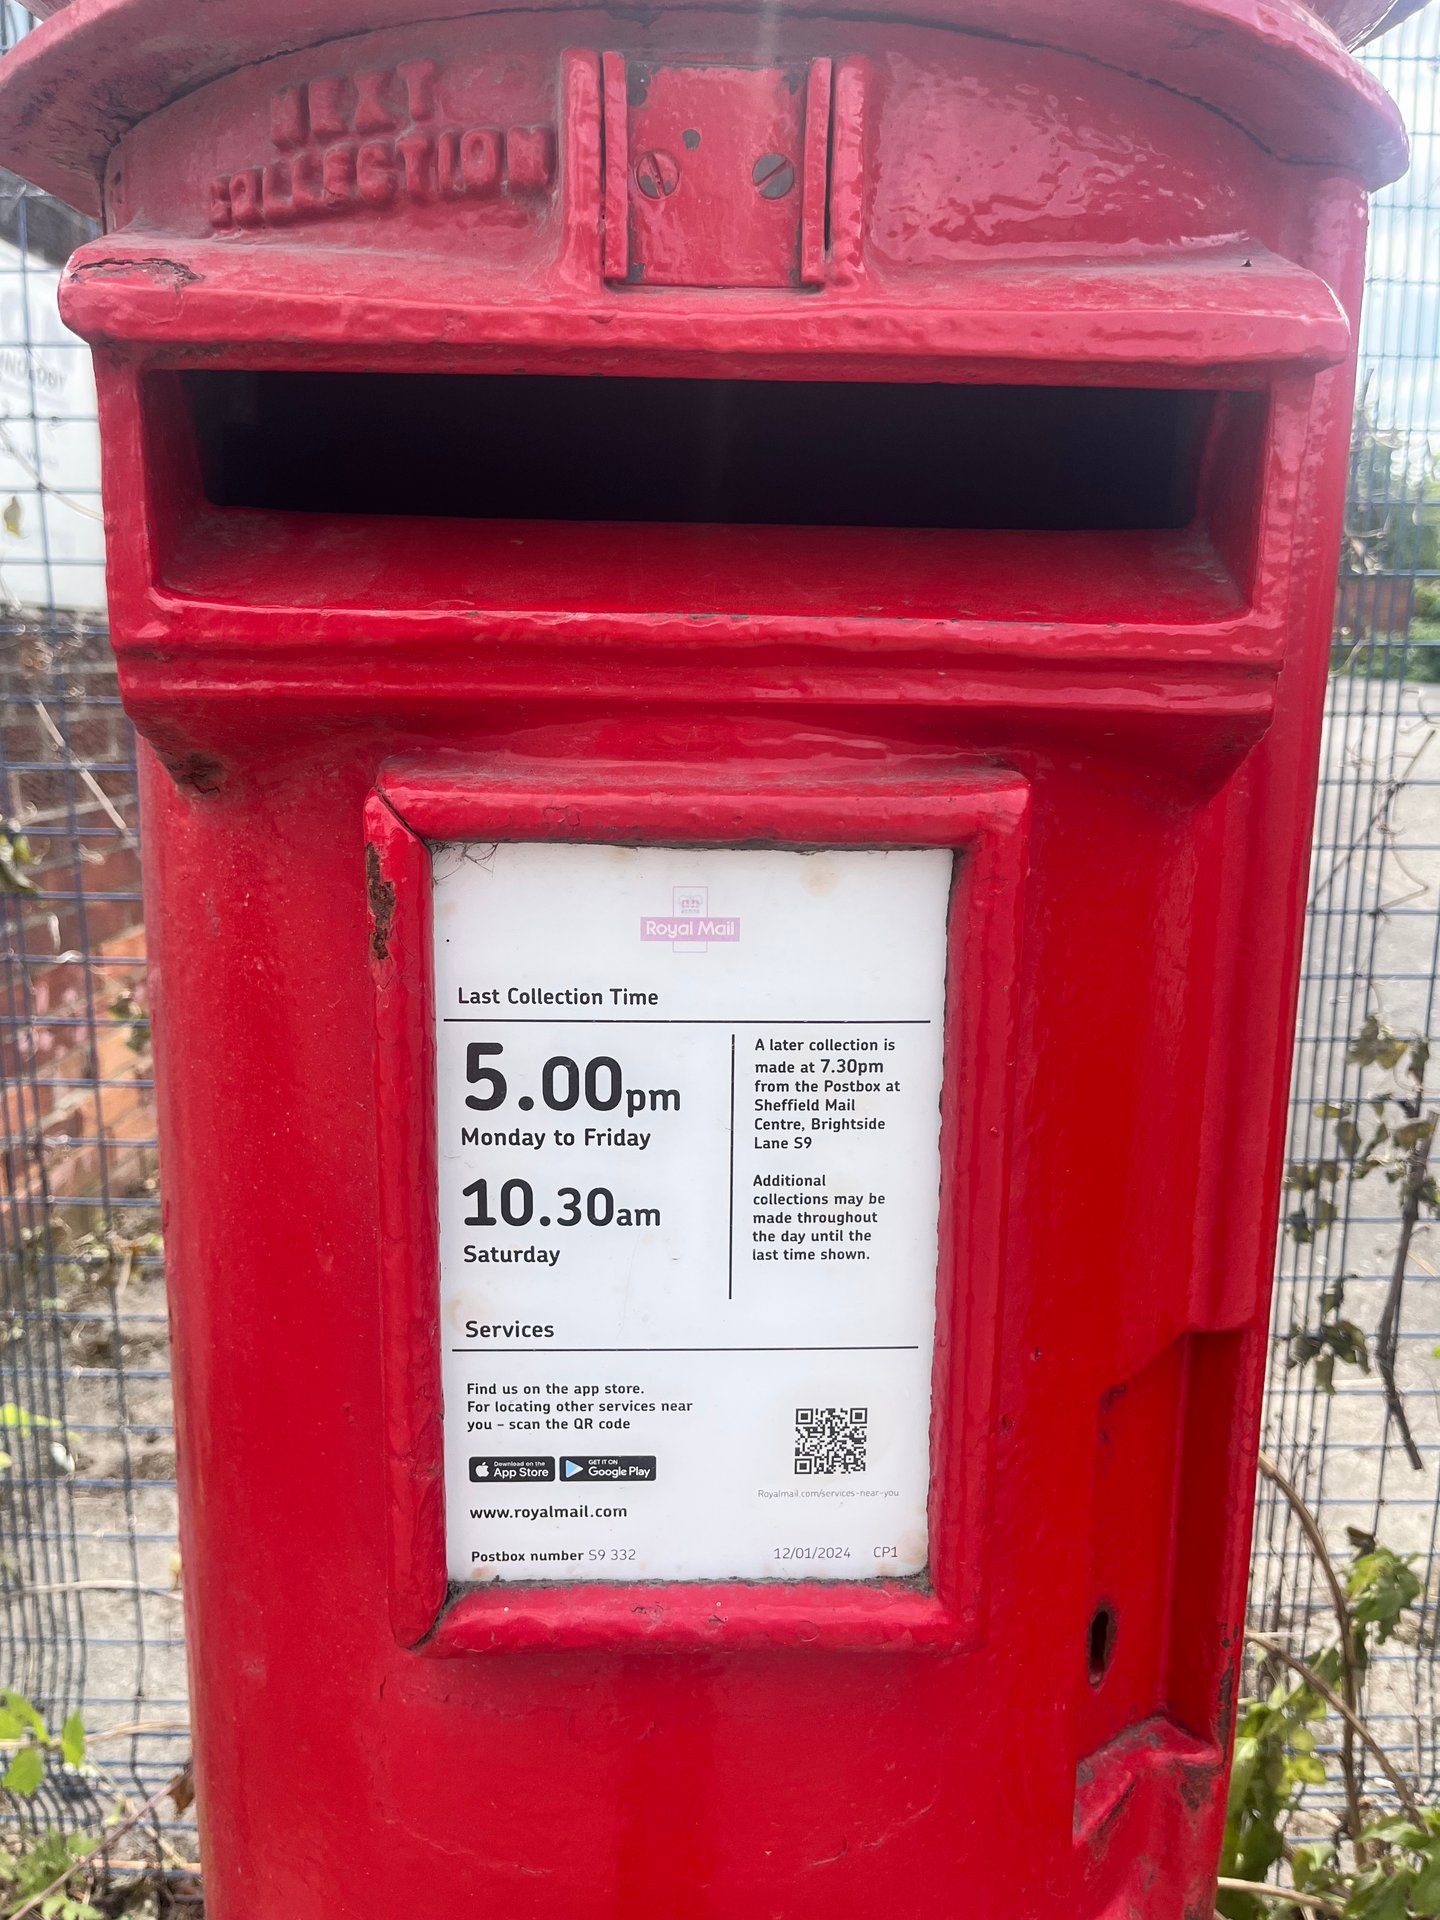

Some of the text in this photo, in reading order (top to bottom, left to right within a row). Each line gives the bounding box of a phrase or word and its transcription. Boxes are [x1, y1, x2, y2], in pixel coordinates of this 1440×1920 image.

[270, 57, 437, 151] NEXT
[208, 123, 552, 229] COLLECTION
[647, 921, 734, 938] Royal Mail
[458, 987, 658, 1005] Last Collection Time
[755, 1038, 895, 1051] A later collection is
[755, 1059, 883, 1076] made at 7.30pm
[465, 1042, 680, 1118] 5.00pm
[754, 1080, 900, 1092] from the Postbox at
[755, 1098, 855, 1111] Sheffield Mail
[755, 1117, 885, 1133] Centre, Brightside
[461, 1127, 651, 1150] Monday to Friday
[754, 1136, 812, 1149] Lane S9
[753, 1174, 826, 1187] Additional
[462, 1178, 660, 1227] 10.30am
[753, 1192, 885, 1207] collections may be
[753, 1211, 878, 1226] made throughout
[752, 1229, 871, 1245] the day until the
[464, 1245, 560, 1267] Saturday
[753, 1248, 870, 1260] last time shown.
[465, 1320, 554, 1338] Services
[467, 1383, 644, 1397] Find us on the app store.
[468, 1400, 693, 1414] For locating other services near
[467, 1421, 492, 1433] you
[509, 1421, 540, 1430] scan
[545, 1418, 568, 1429] the
[574, 1418, 593, 1430] QR
[599, 1418, 630, 1429] code
[493, 1467, 549, 1479] App Store
[588, 1466, 650, 1478] Google Play
[758, 1489, 899, 1499] Royalmail.com/services-near-you
[470, 1505, 627, 1521] www.royalmail.com
[472, 1550, 635, 1562] Postbox number S9 332
[774, 1546, 898, 1559] 12/01/2024 CP1
